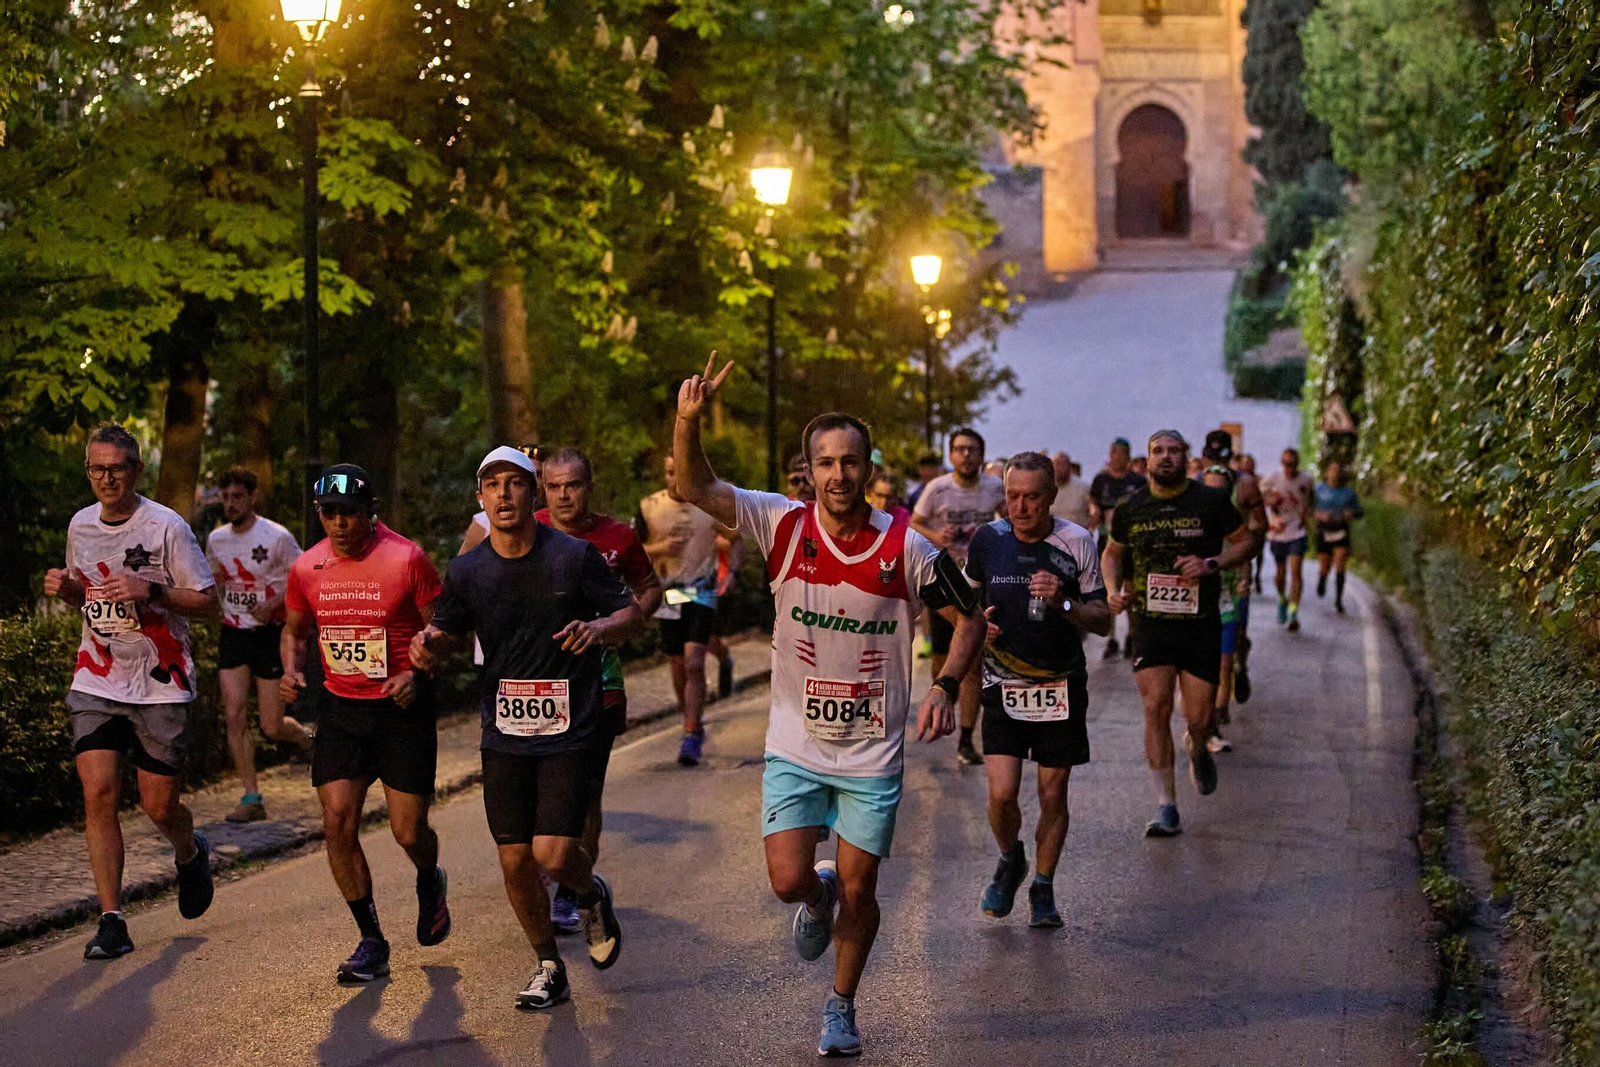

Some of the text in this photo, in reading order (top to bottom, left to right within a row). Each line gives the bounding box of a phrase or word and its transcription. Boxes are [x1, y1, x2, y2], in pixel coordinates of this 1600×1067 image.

[367, 581, 380, 589] de
[226, 592, 257, 606] 4828
[319, 589, 381, 601] humanidad
[1150, 586, 1190, 602] 2222
[791, 606, 898, 635] COVIRAN
[322, 628, 331, 640] 41
[329, 643, 367, 662] 555
[807, 681, 820, 695] 41
[1005, 690, 1057, 708] 5115
[499, 698, 556, 719] 3860
[805, 698, 871, 723] 5084
